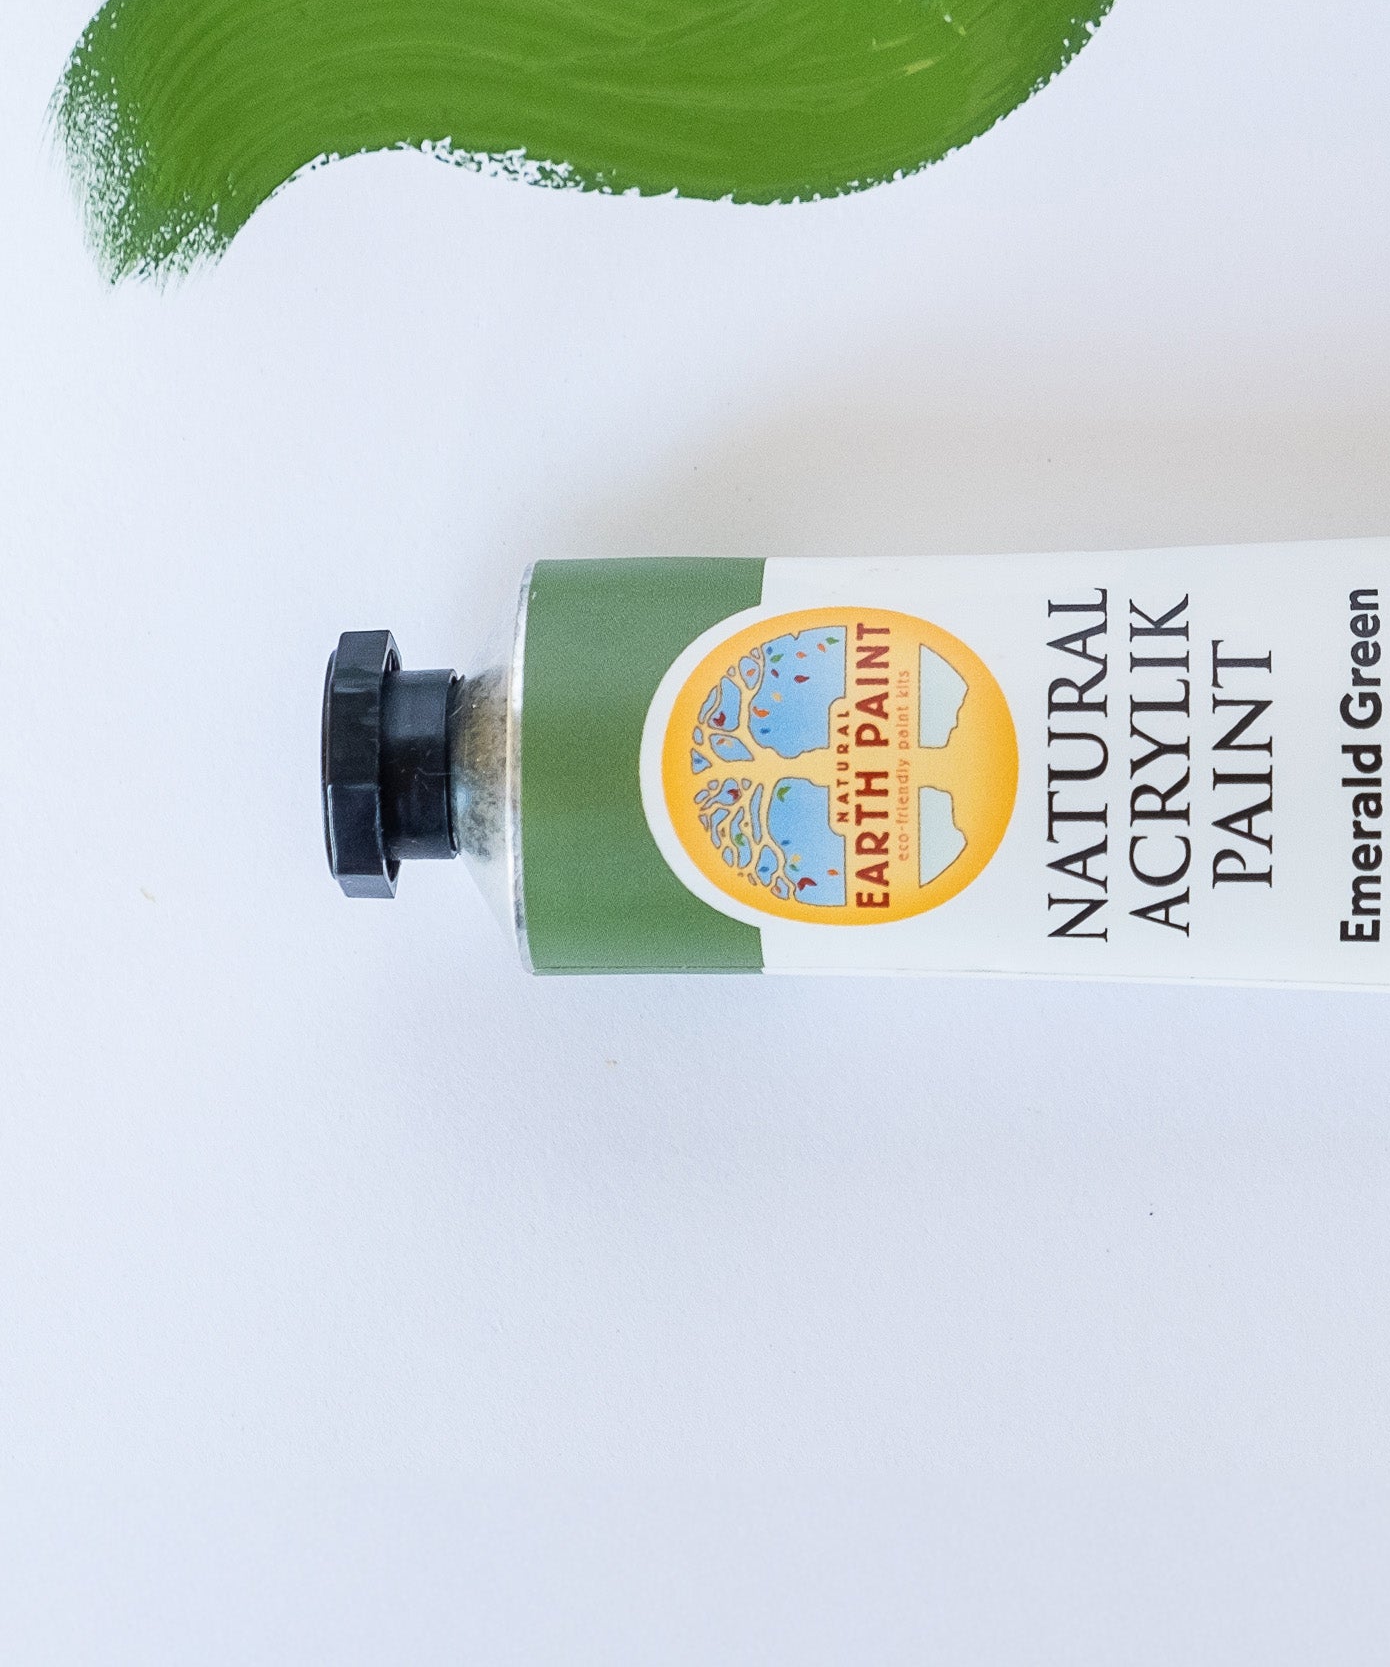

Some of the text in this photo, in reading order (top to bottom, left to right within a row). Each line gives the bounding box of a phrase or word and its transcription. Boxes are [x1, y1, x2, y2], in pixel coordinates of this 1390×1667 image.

[836, 710, 850, 823] NATURAL
[857, 624, 891, 907] EARTH PAINT
[895, 670, 911, 862] eco-friendly paint kits
[1046, 587, 1109, 941] NATURAL
[1128, 593, 1192, 937] ACRYLIK
[1211, 639, 1273, 888] PAINT
[1339, 588, 1383, 942] Emerald Green
